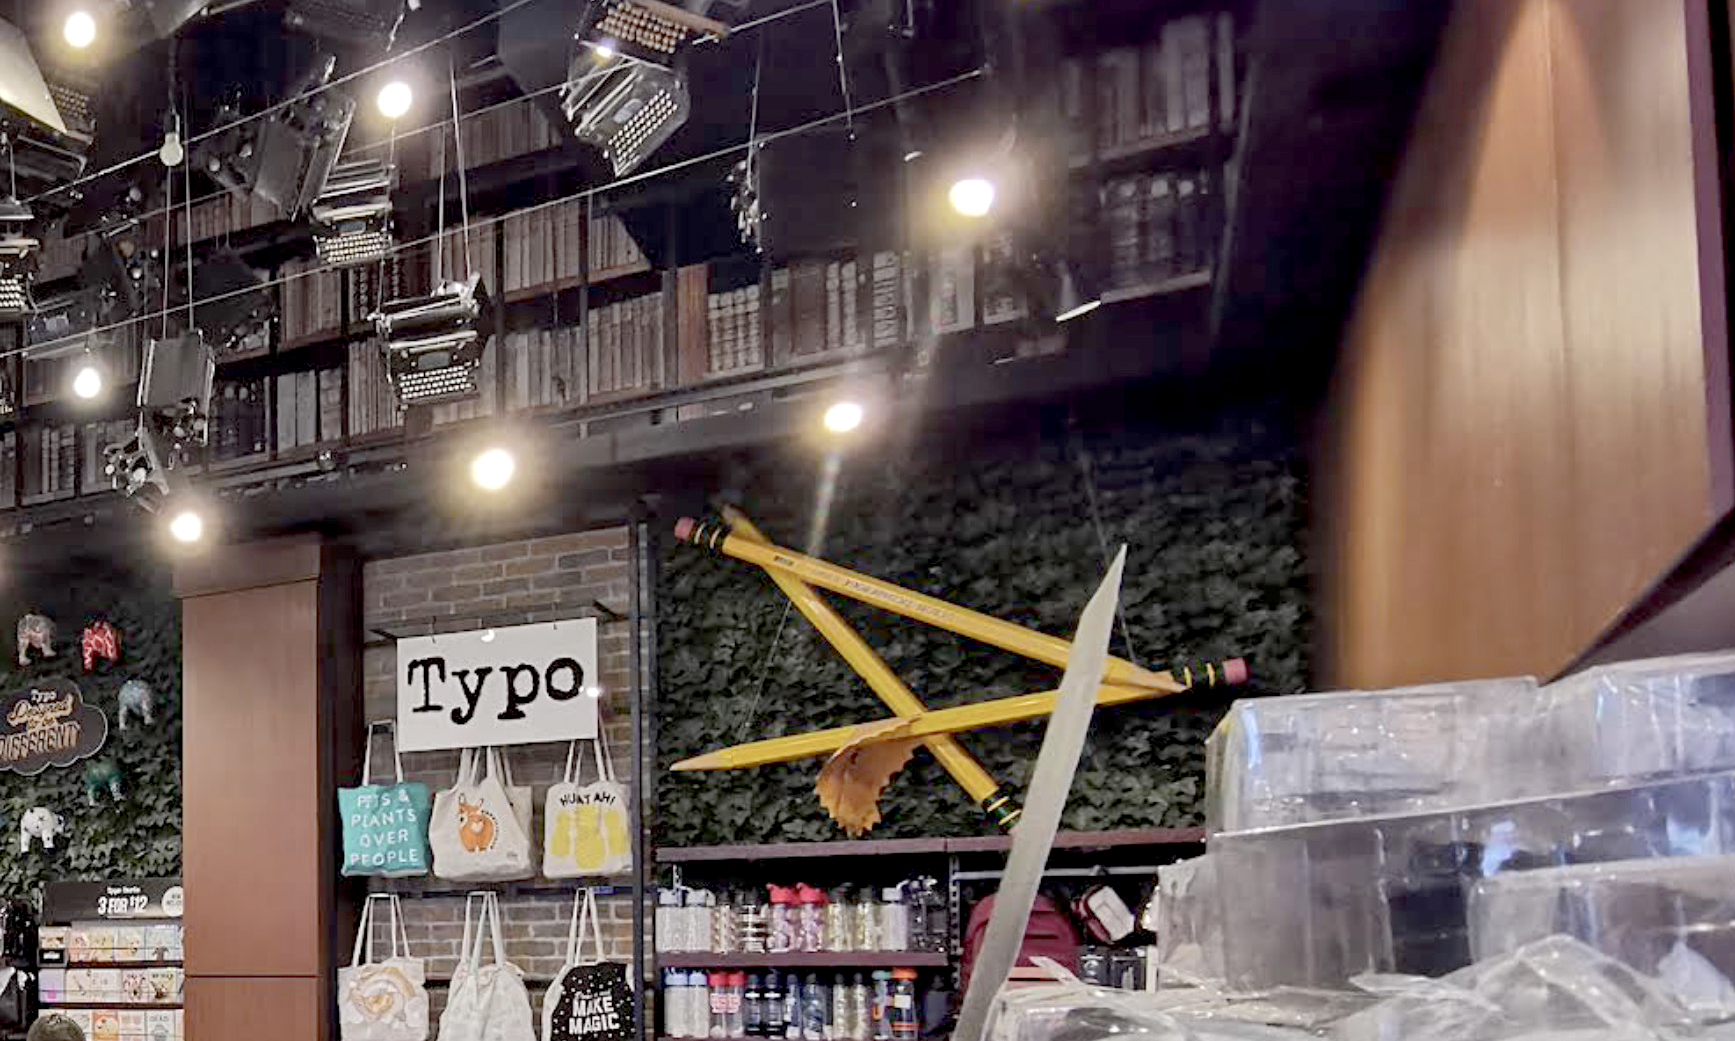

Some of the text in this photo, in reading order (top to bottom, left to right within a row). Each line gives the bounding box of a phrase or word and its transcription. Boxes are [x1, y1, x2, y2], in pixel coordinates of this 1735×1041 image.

[407, 657, 584, 725] Typo
[351, 808, 417, 828] PLANTS
[359, 828, 409, 849] OVER
[350, 848, 418, 866] PEOPLE
[97, 896, 108, 915] 3
[108, 896, 129, 915] FOR
[572, 995, 615, 1017] MAKE
[569, 1012, 620, 1035] MAGIC
